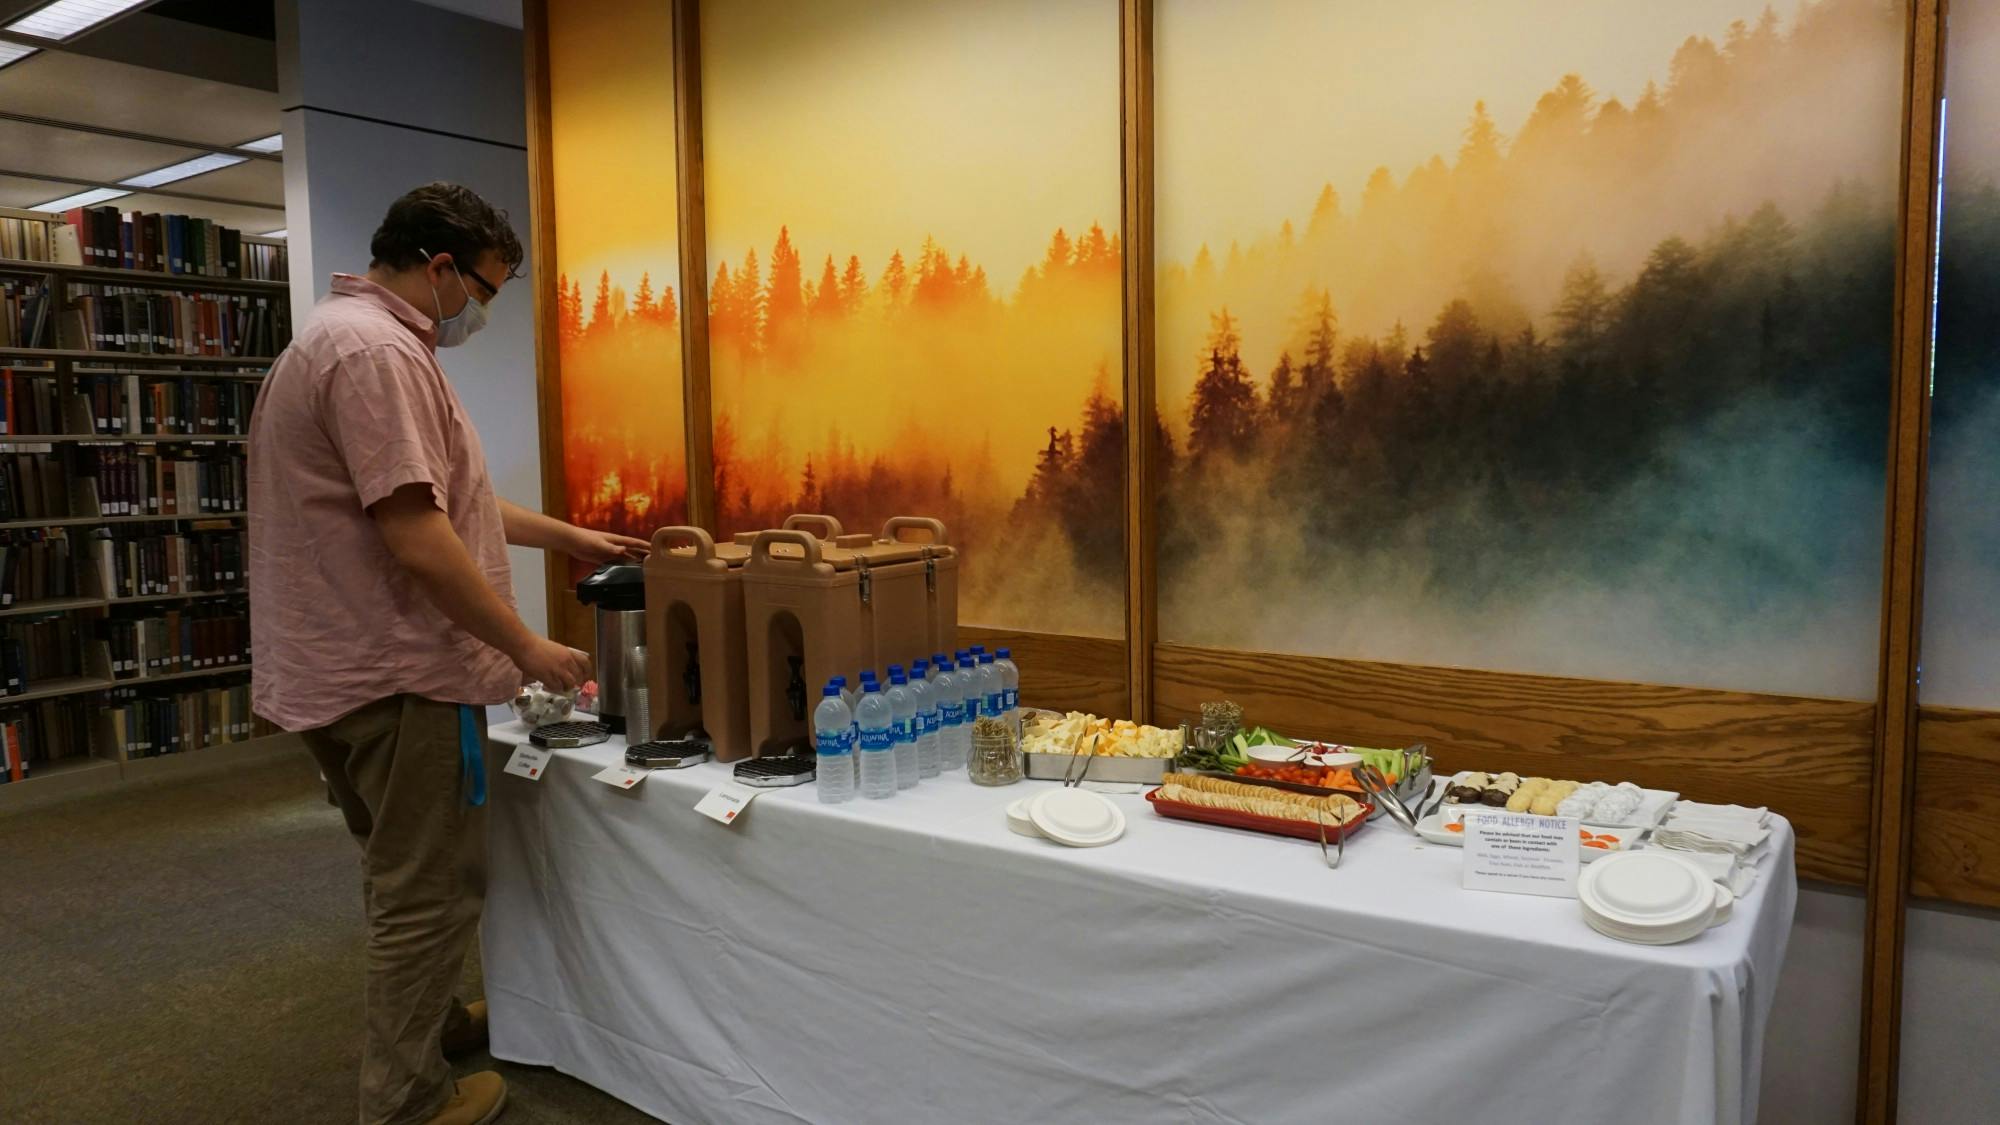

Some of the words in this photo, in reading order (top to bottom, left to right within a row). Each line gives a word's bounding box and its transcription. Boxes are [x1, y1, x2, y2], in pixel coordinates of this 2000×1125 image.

[1477, 815, 1498, 825] FOOD
[1502, 816, 1534, 827] ALLERGY
[1539, 818, 1567, 829] NOTICE
